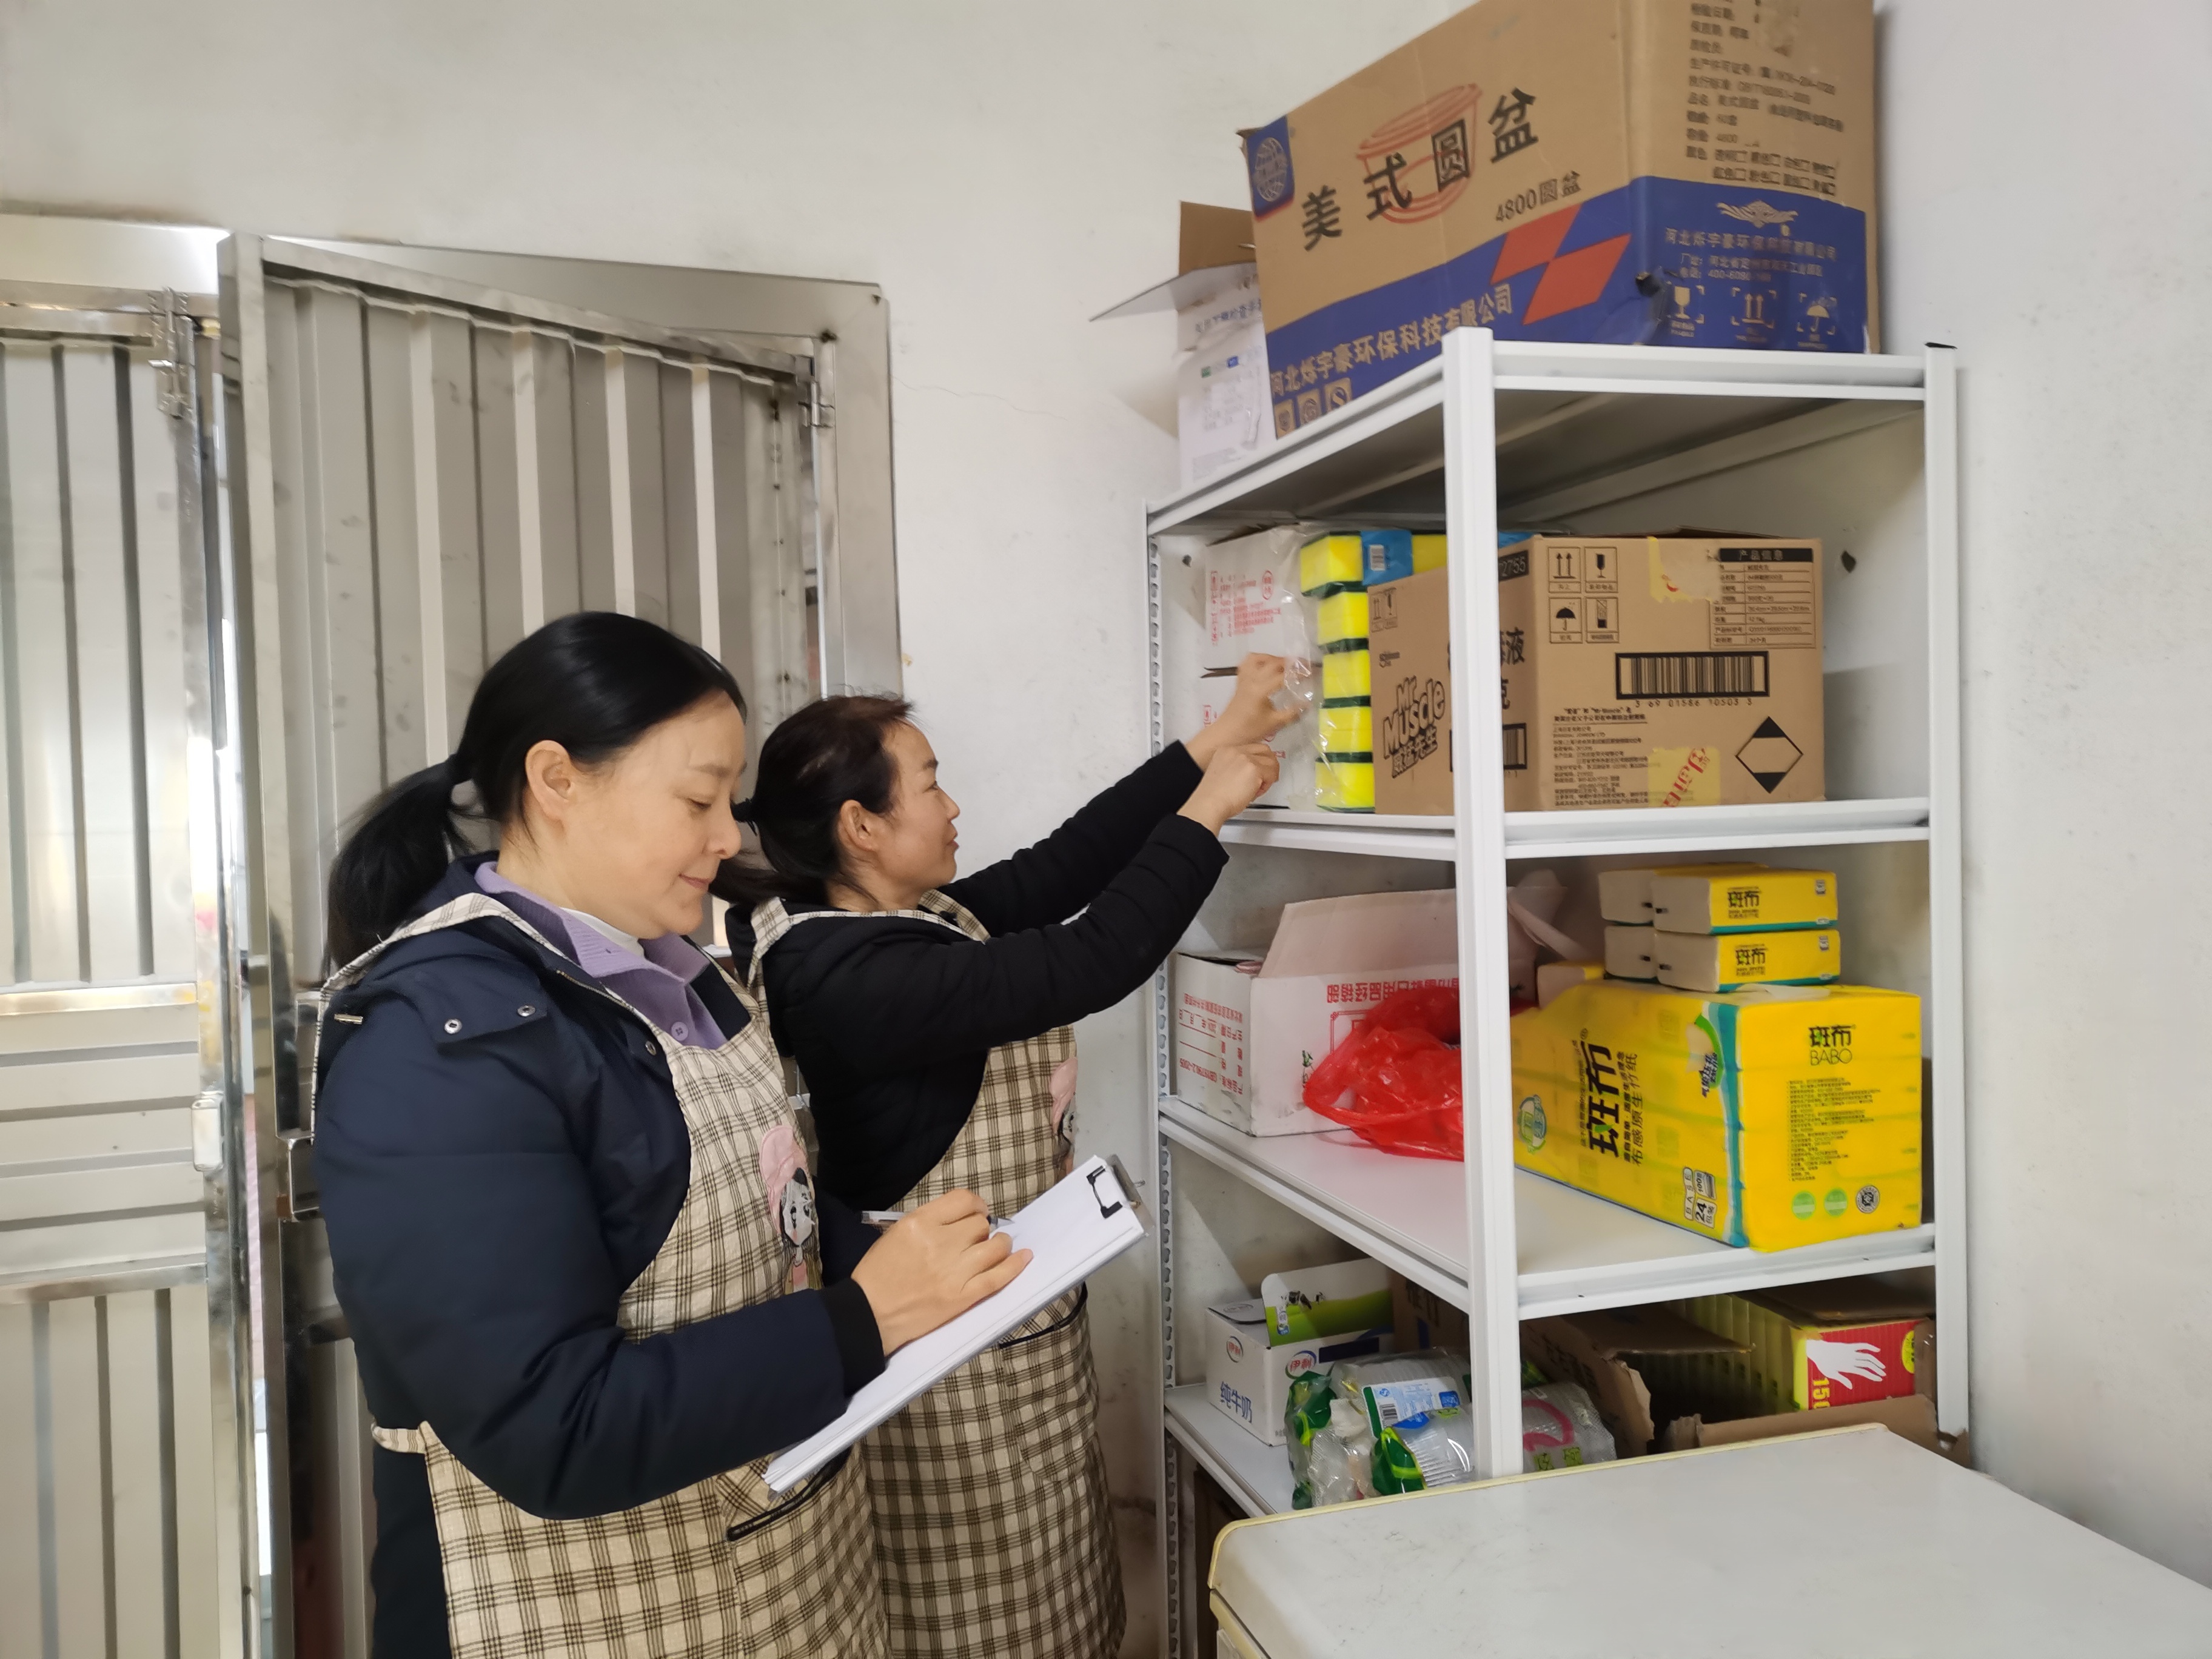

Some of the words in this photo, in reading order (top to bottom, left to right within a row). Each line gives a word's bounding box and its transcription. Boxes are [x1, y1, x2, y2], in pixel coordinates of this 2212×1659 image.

[1302, 87, 1538, 252] 美式圆盆
[1495, 170, 1581, 223] 4800圆盆
[1396, 675, 1418, 710] Mr
[1383, 678, 1446, 760] Muscle
[1809, 1025, 1851, 1047] 斑布
[1811, 1048, 1853, 1066] BABO
[1580, 1039, 1620, 1158] 斑布
[1695, 1202, 1707, 1222] 24
[1220, 1381, 1253, 1424] 纯牛奶
